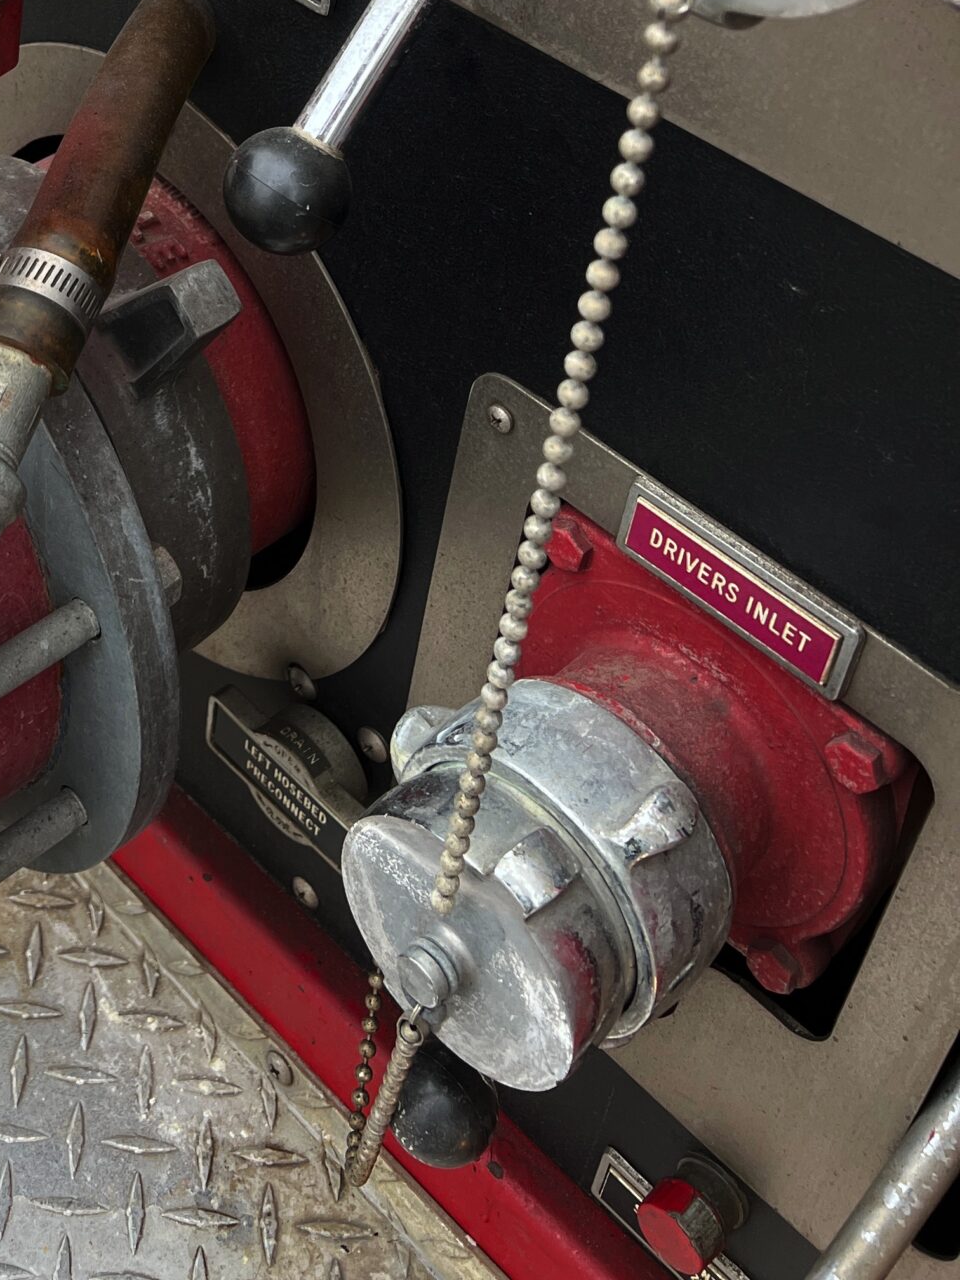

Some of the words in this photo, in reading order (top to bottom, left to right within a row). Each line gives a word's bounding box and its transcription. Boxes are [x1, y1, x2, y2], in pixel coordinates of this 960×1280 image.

[649, 527, 740, 603] DRIVERS
[745, 596, 811, 652] INLET
[244, 739, 272, 771] LEFT
[273, 767, 327, 825] HOSEBED
[279, 726, 321, 767] DRAIN
[246, 760, 321, 837] PRECONNECT
